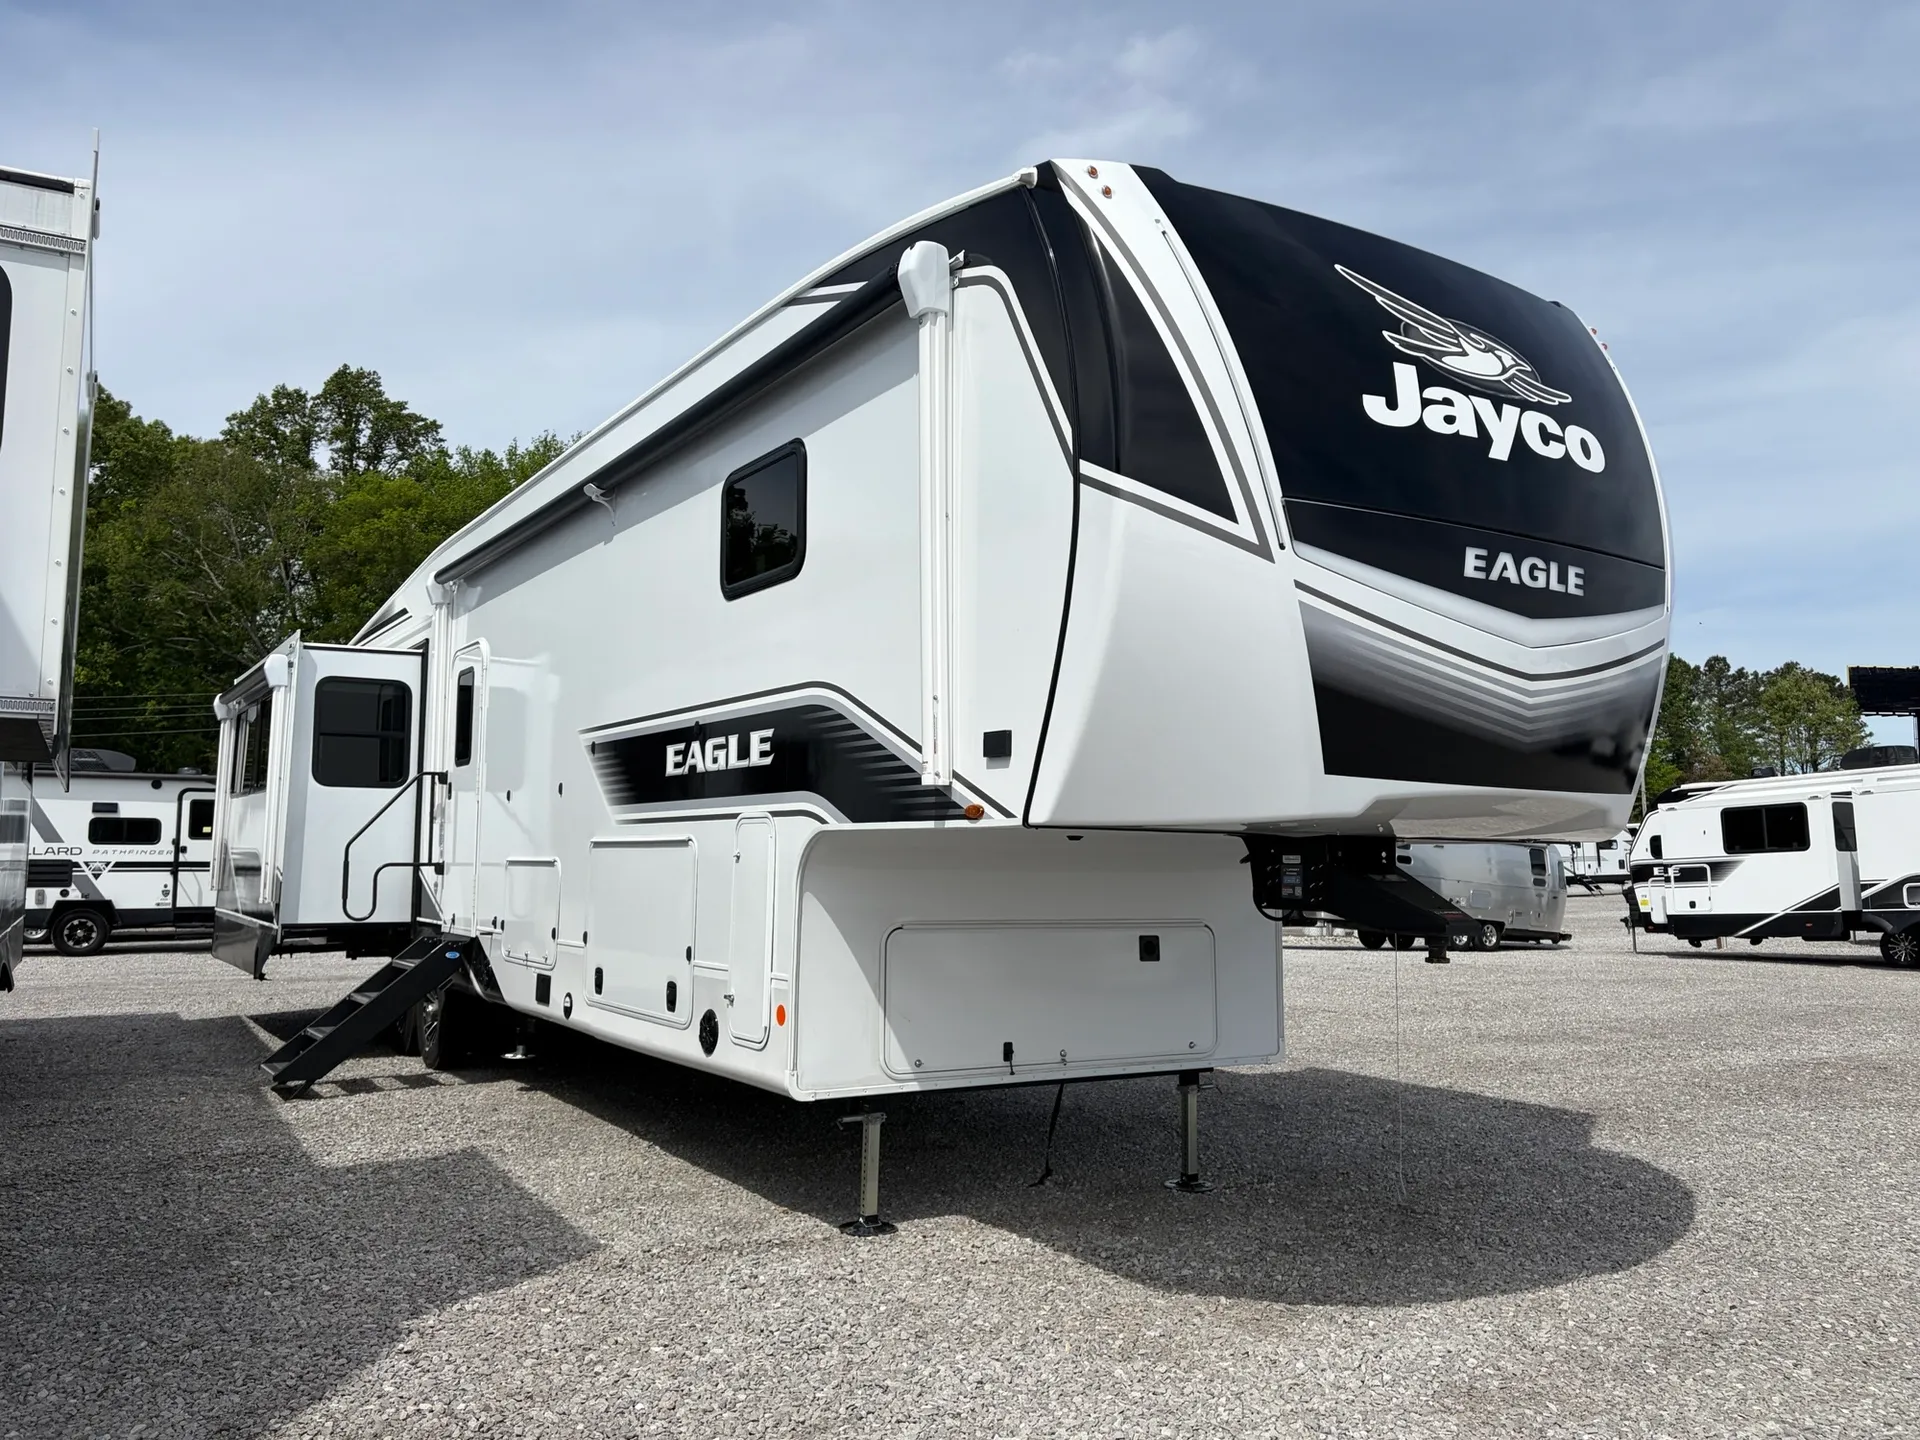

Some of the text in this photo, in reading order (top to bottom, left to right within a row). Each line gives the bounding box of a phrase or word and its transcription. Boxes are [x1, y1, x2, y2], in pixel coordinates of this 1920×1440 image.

[1362, 361, 1606, 474] Jayco
[1463, 546, 1586, 597] EAGLE
[665, 728, 775, 777] EAGLE
[28, 846, 83, 856] LARD
